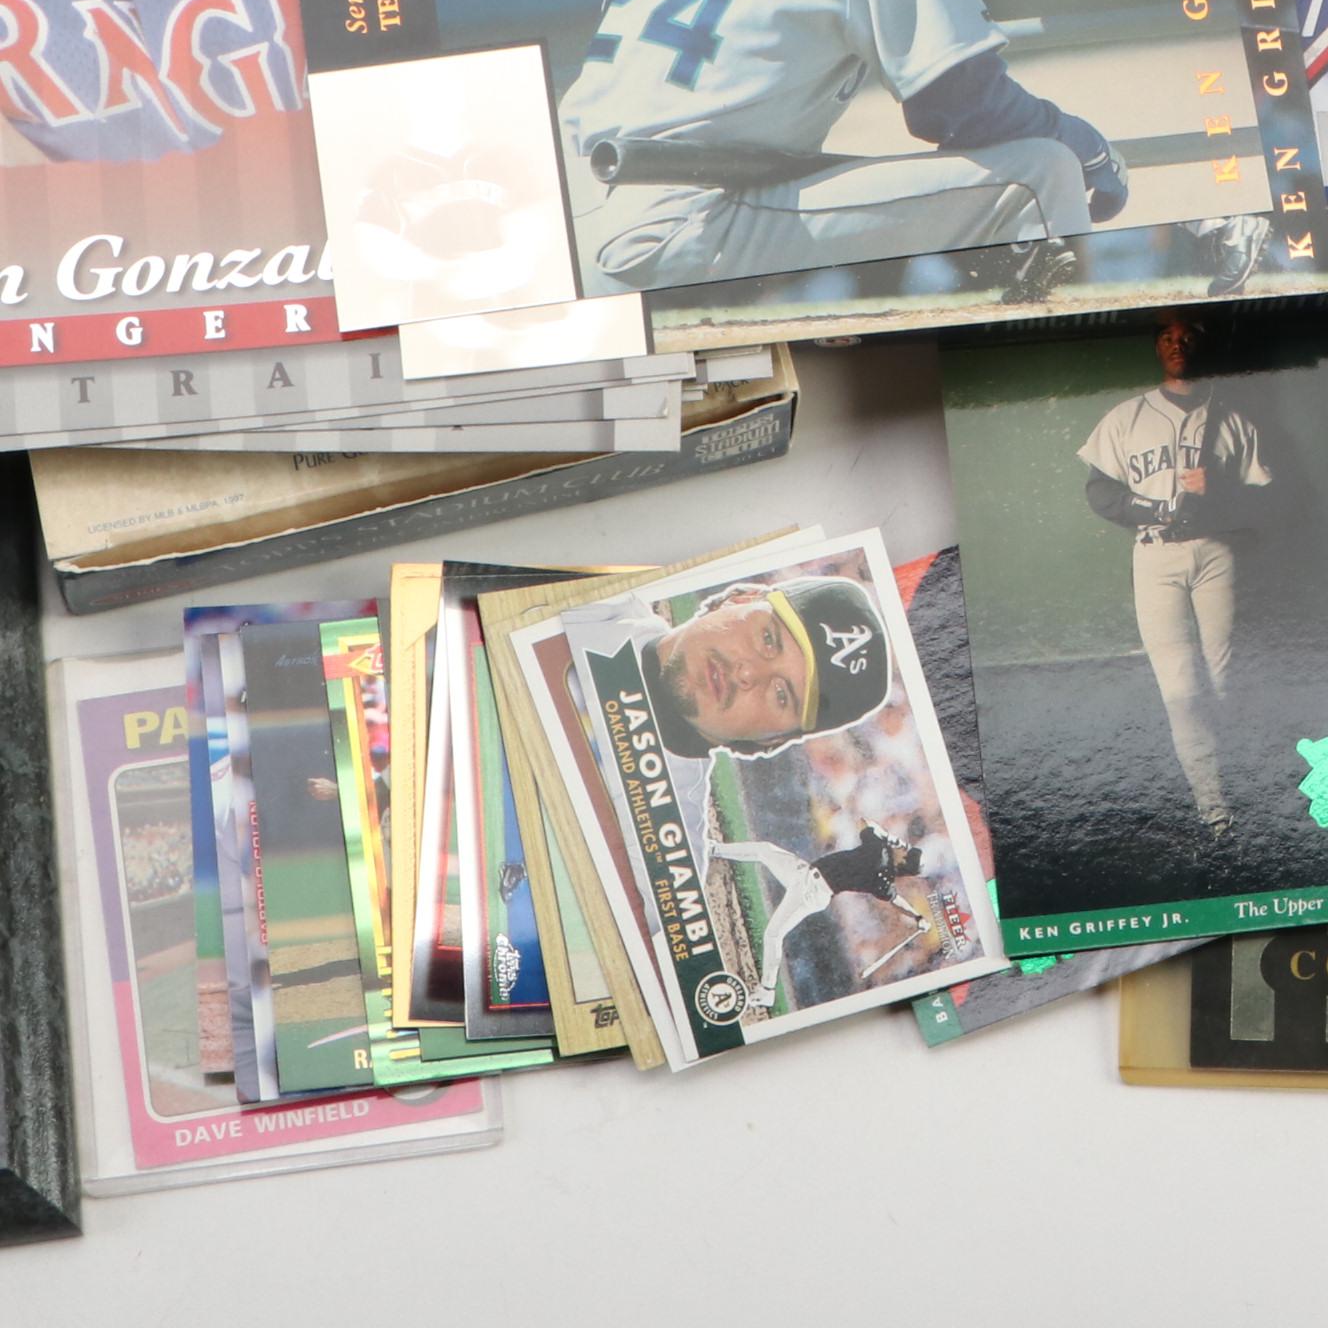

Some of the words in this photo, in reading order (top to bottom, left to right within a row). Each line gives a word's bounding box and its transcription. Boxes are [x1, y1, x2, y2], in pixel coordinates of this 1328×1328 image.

[605, 700, 636, 774] OAKLAND
[655, 879, 678, 919] FIRST
[667, 923, 689, 962] BASE
[619, 690, 672, 807] JASON
[659, 822, 714, 955] GIAMBI
[943, 893, 967, 951] FLEER
[1019, 924, 1060, 941] KEN
[1069, 915, 1154, 935] GRIFFEY
[1161, 912, 1190, 927] JR.
[1235, 898, 1268, 919] The
[1272, 894, 1325, 917] Upper
[175, 1119, 244, 1147] DAVE
[255, 1100, 370, 1134] WINFIELD
